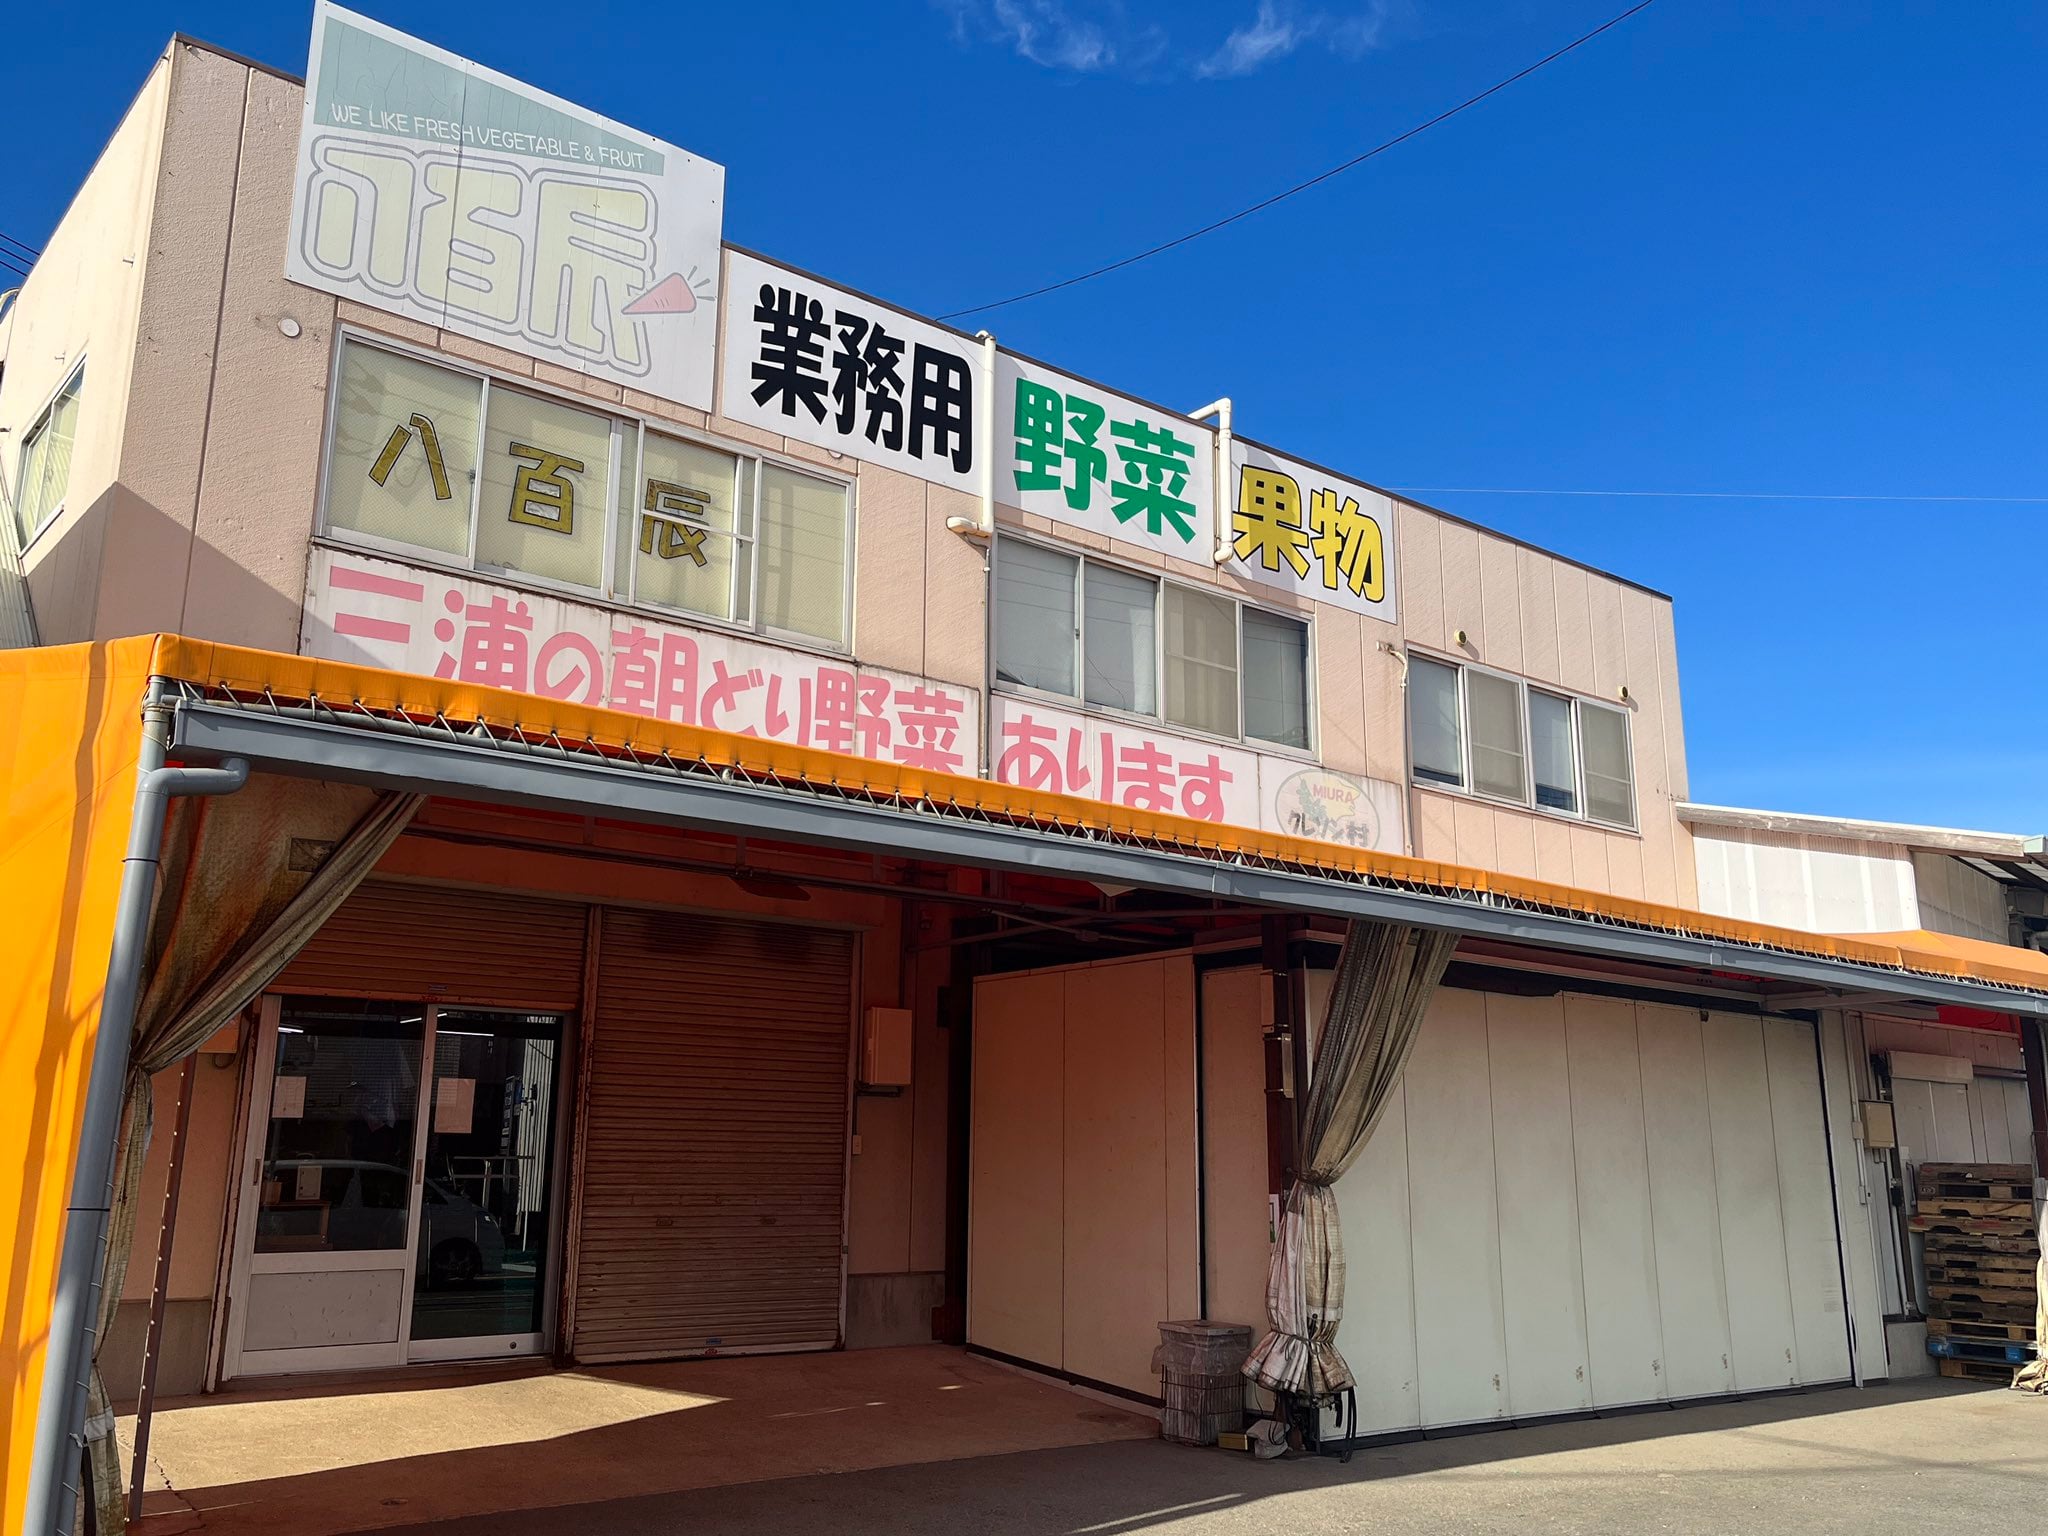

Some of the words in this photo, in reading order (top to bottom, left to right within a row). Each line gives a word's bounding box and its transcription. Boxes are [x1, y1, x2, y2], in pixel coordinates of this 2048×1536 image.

[332, 103, 362, 125] WE
[368, 104, 410, 133] LIKE
[414, 116, 475, 143] FRESH
[477, 125, 581, 159] VEGETABLE
[584, 145, 596, 162] &
[599, 146, 645, 169] FRUIT
[751, 283, 973, 474] 業務用
[368, 413, 711, 567] 八百辰
[1014, 377, 1197, 544] 野菜
[1232, 464, 1386, 604] 果物
[997, 714, 1234, 823] あります
[1312, 784, 1354, 804] MIURA
